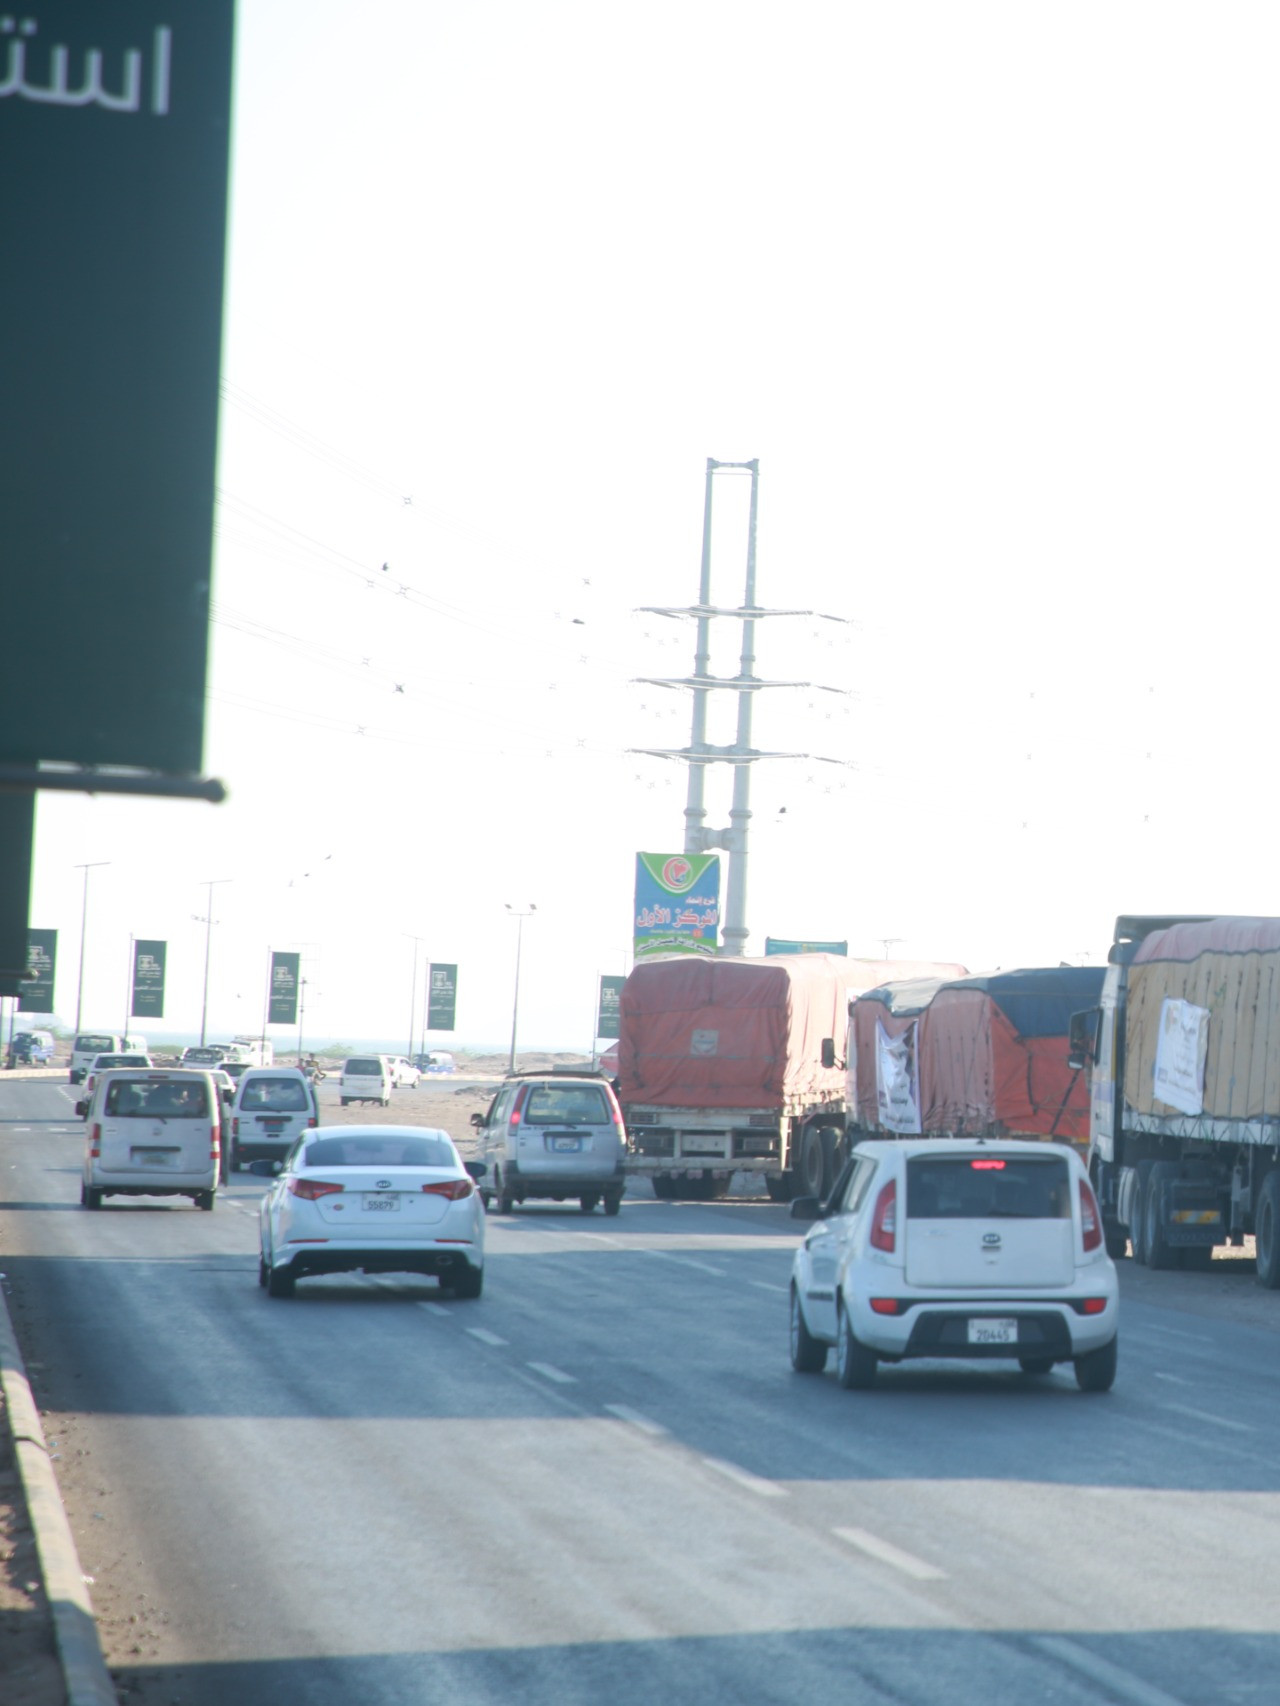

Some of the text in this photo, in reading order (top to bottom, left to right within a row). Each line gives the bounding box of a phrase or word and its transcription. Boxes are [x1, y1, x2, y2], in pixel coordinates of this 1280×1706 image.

[0, 16, 172, 116] است
[637, 904, 718, 928] المركز الأول
